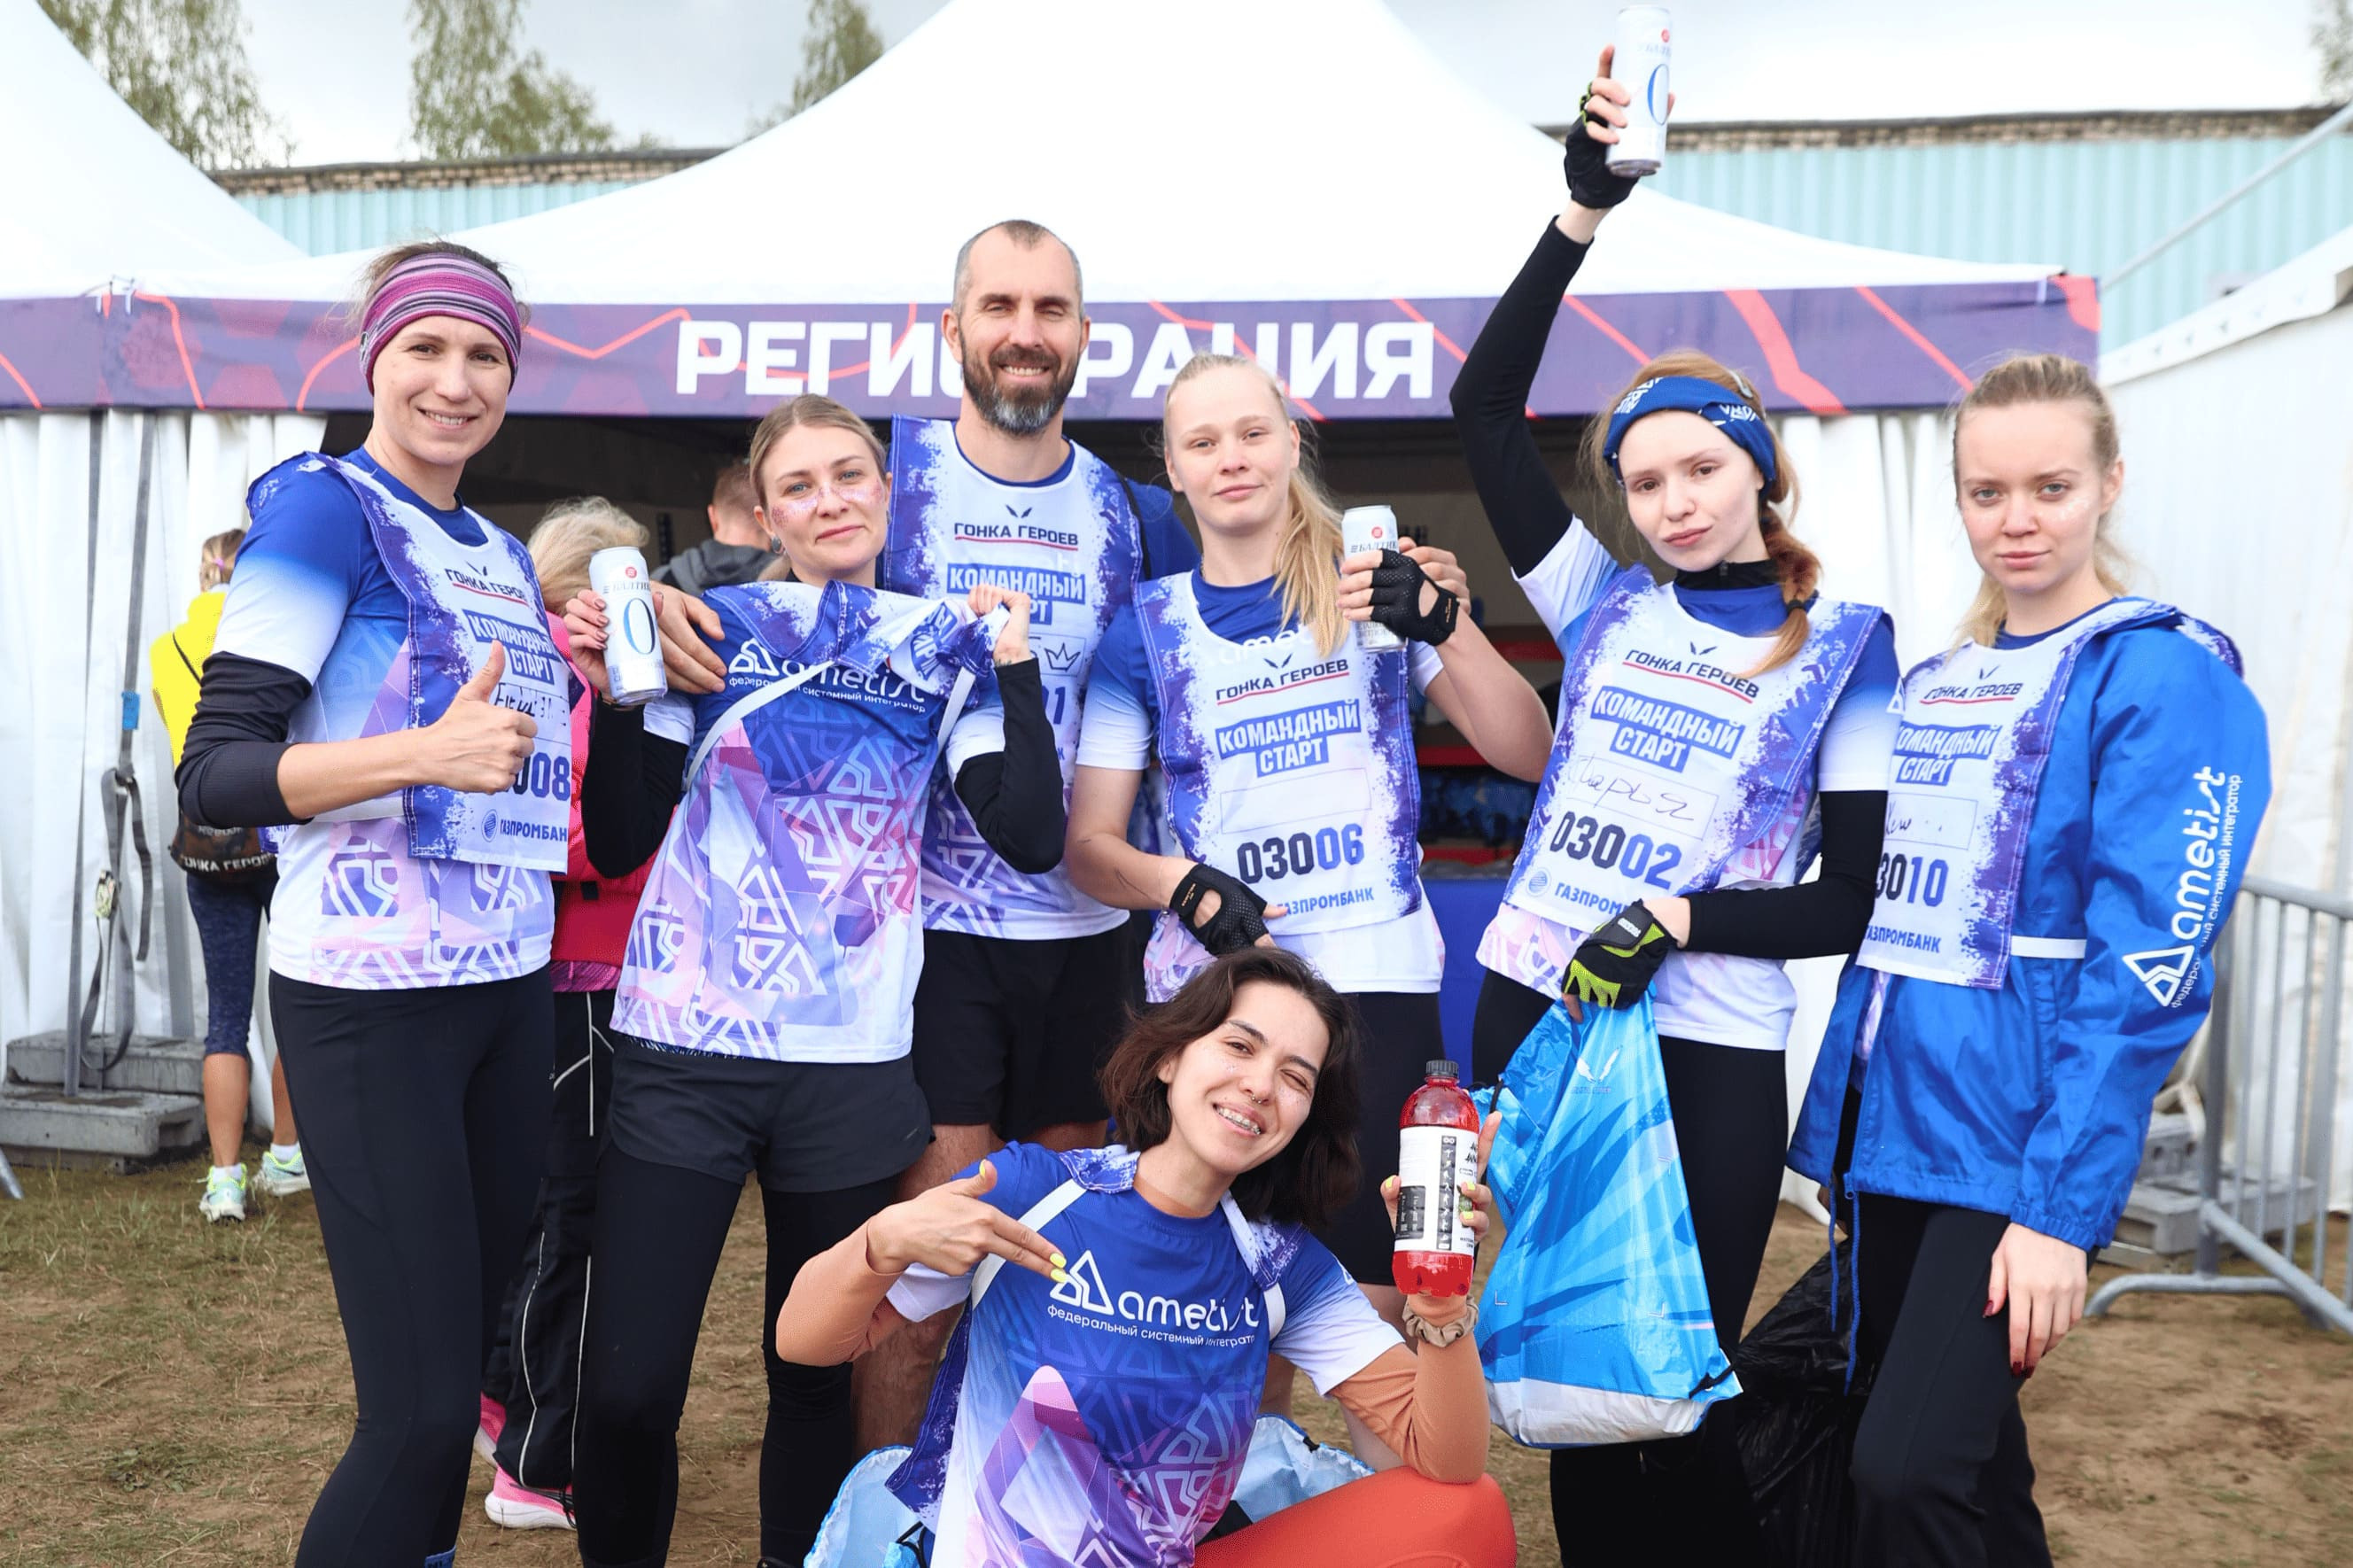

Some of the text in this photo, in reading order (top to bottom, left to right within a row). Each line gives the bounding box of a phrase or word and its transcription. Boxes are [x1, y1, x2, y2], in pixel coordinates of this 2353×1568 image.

[676, 322, 1434, 399] РЕГИРАЦИЯ
[954, 523, 1078, 546] ГОНКА ГЕРОЕВ
[445, 568, 527, 602] ГОНКА ГЕРО
[467, 614, 554, 655] КОМАНДНЫ
[511, 649, 551, 681] СТАРТ
[1216, 659, 1348, 701] ГОНКА ГЕРОЕВ
[1625, 649, 1759, 698] ГОНКА ГЕРОЕВ
[1924, 683, 2023, 699] ГОНКА ГЕРОЕВ
[1218, 699, 1360, 753] КОМАНДНЫЙ
[1594, 688, 1741, 754] КОМАНДНЫЙ
[1260, 738, 1324, 773] СТАРТ
[1615, 727, 1688, 768] СТАРТ
[1900, 758, 1954, 782] СТАРТ
[500, 819, 568, 842] ГАЗПРОМБАН
[1549, 811, 1682, 890] 03002
[2208, 848, 2233, 920] системный
[2224, 774, 2243, 846] интегратор
[1237, 823, 1365, 884] 03006
[1555, 882, 1629, 915] ГАЗПРОМ
[1875, 852, 1949, 907] 3010
[1047, 1304, 1138, 1337] федеральный
[1140, 1328, 1204, 1346] системный
